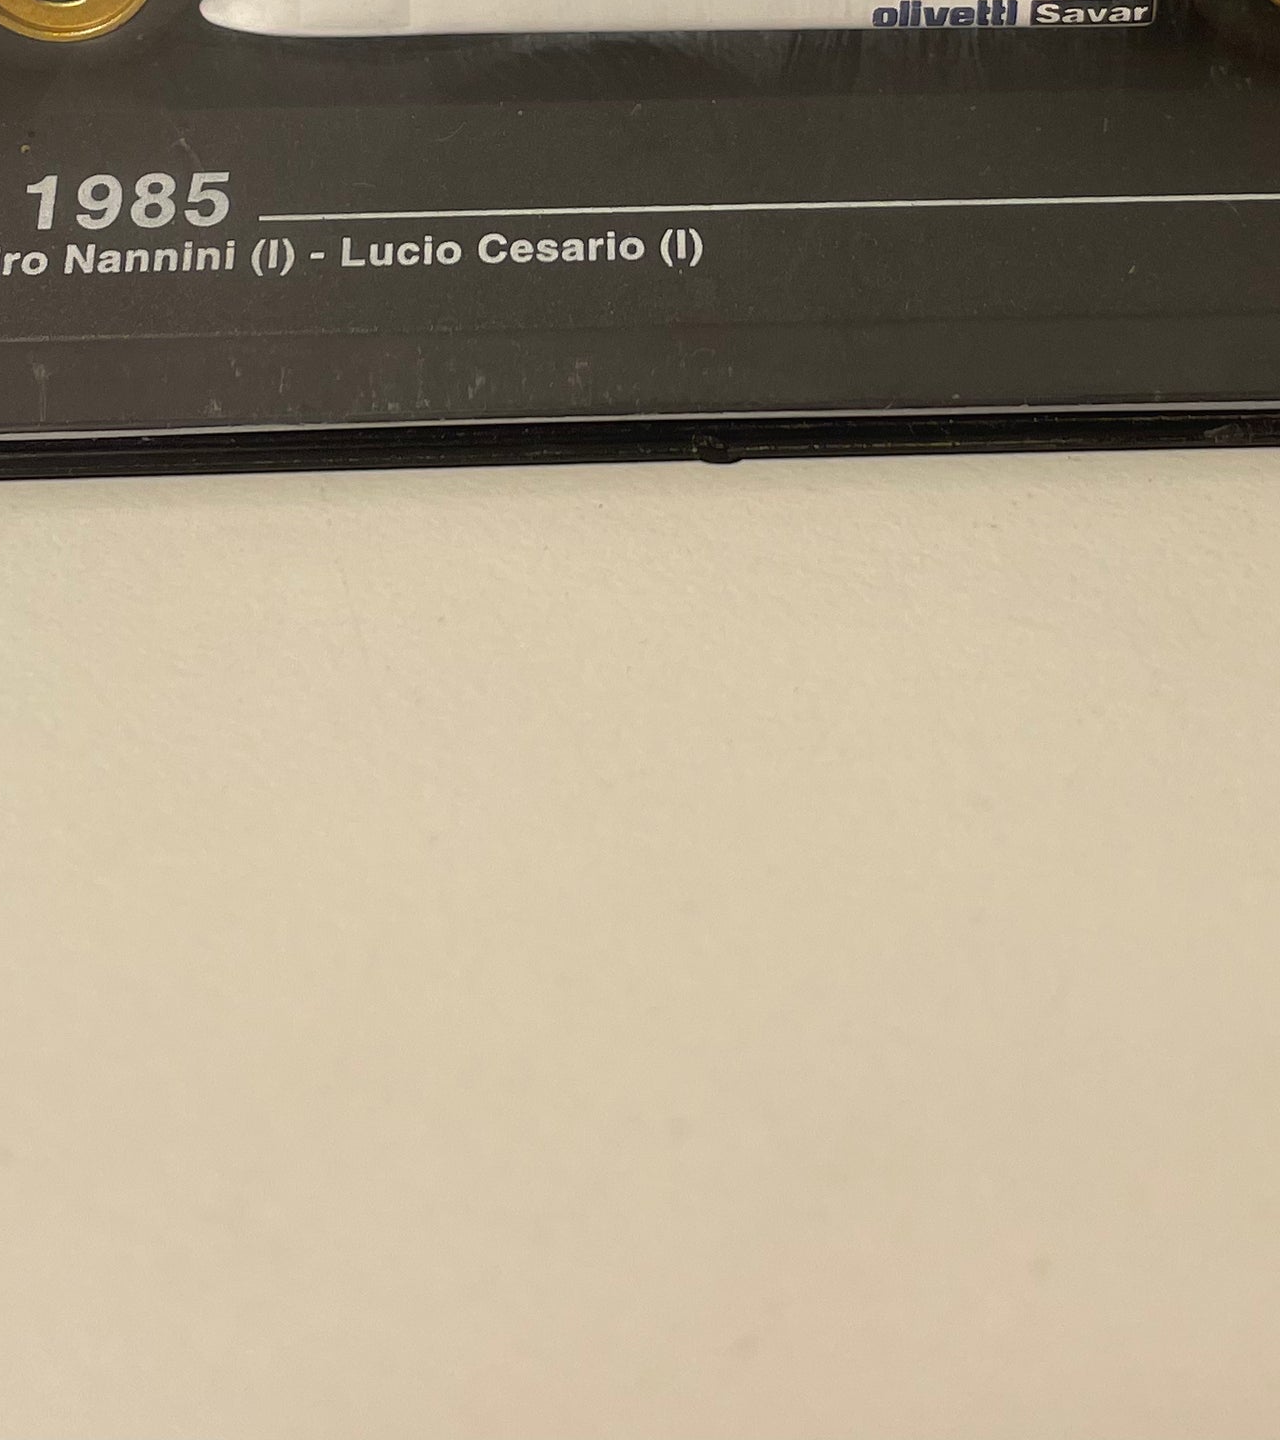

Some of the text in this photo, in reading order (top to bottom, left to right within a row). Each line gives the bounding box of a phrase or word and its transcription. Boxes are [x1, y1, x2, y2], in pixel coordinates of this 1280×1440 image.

[1035, 2, 1150, 25] Savar
[26, 171, 231, 231] 1985
[63, 240, 236, 276] Nannini
[251, 238, 296, 277] (I)
[340, 234, 463, 268] Lucio
[476, 230, 646, 265] Cesario
[659, 227, 704, 268] (I)
